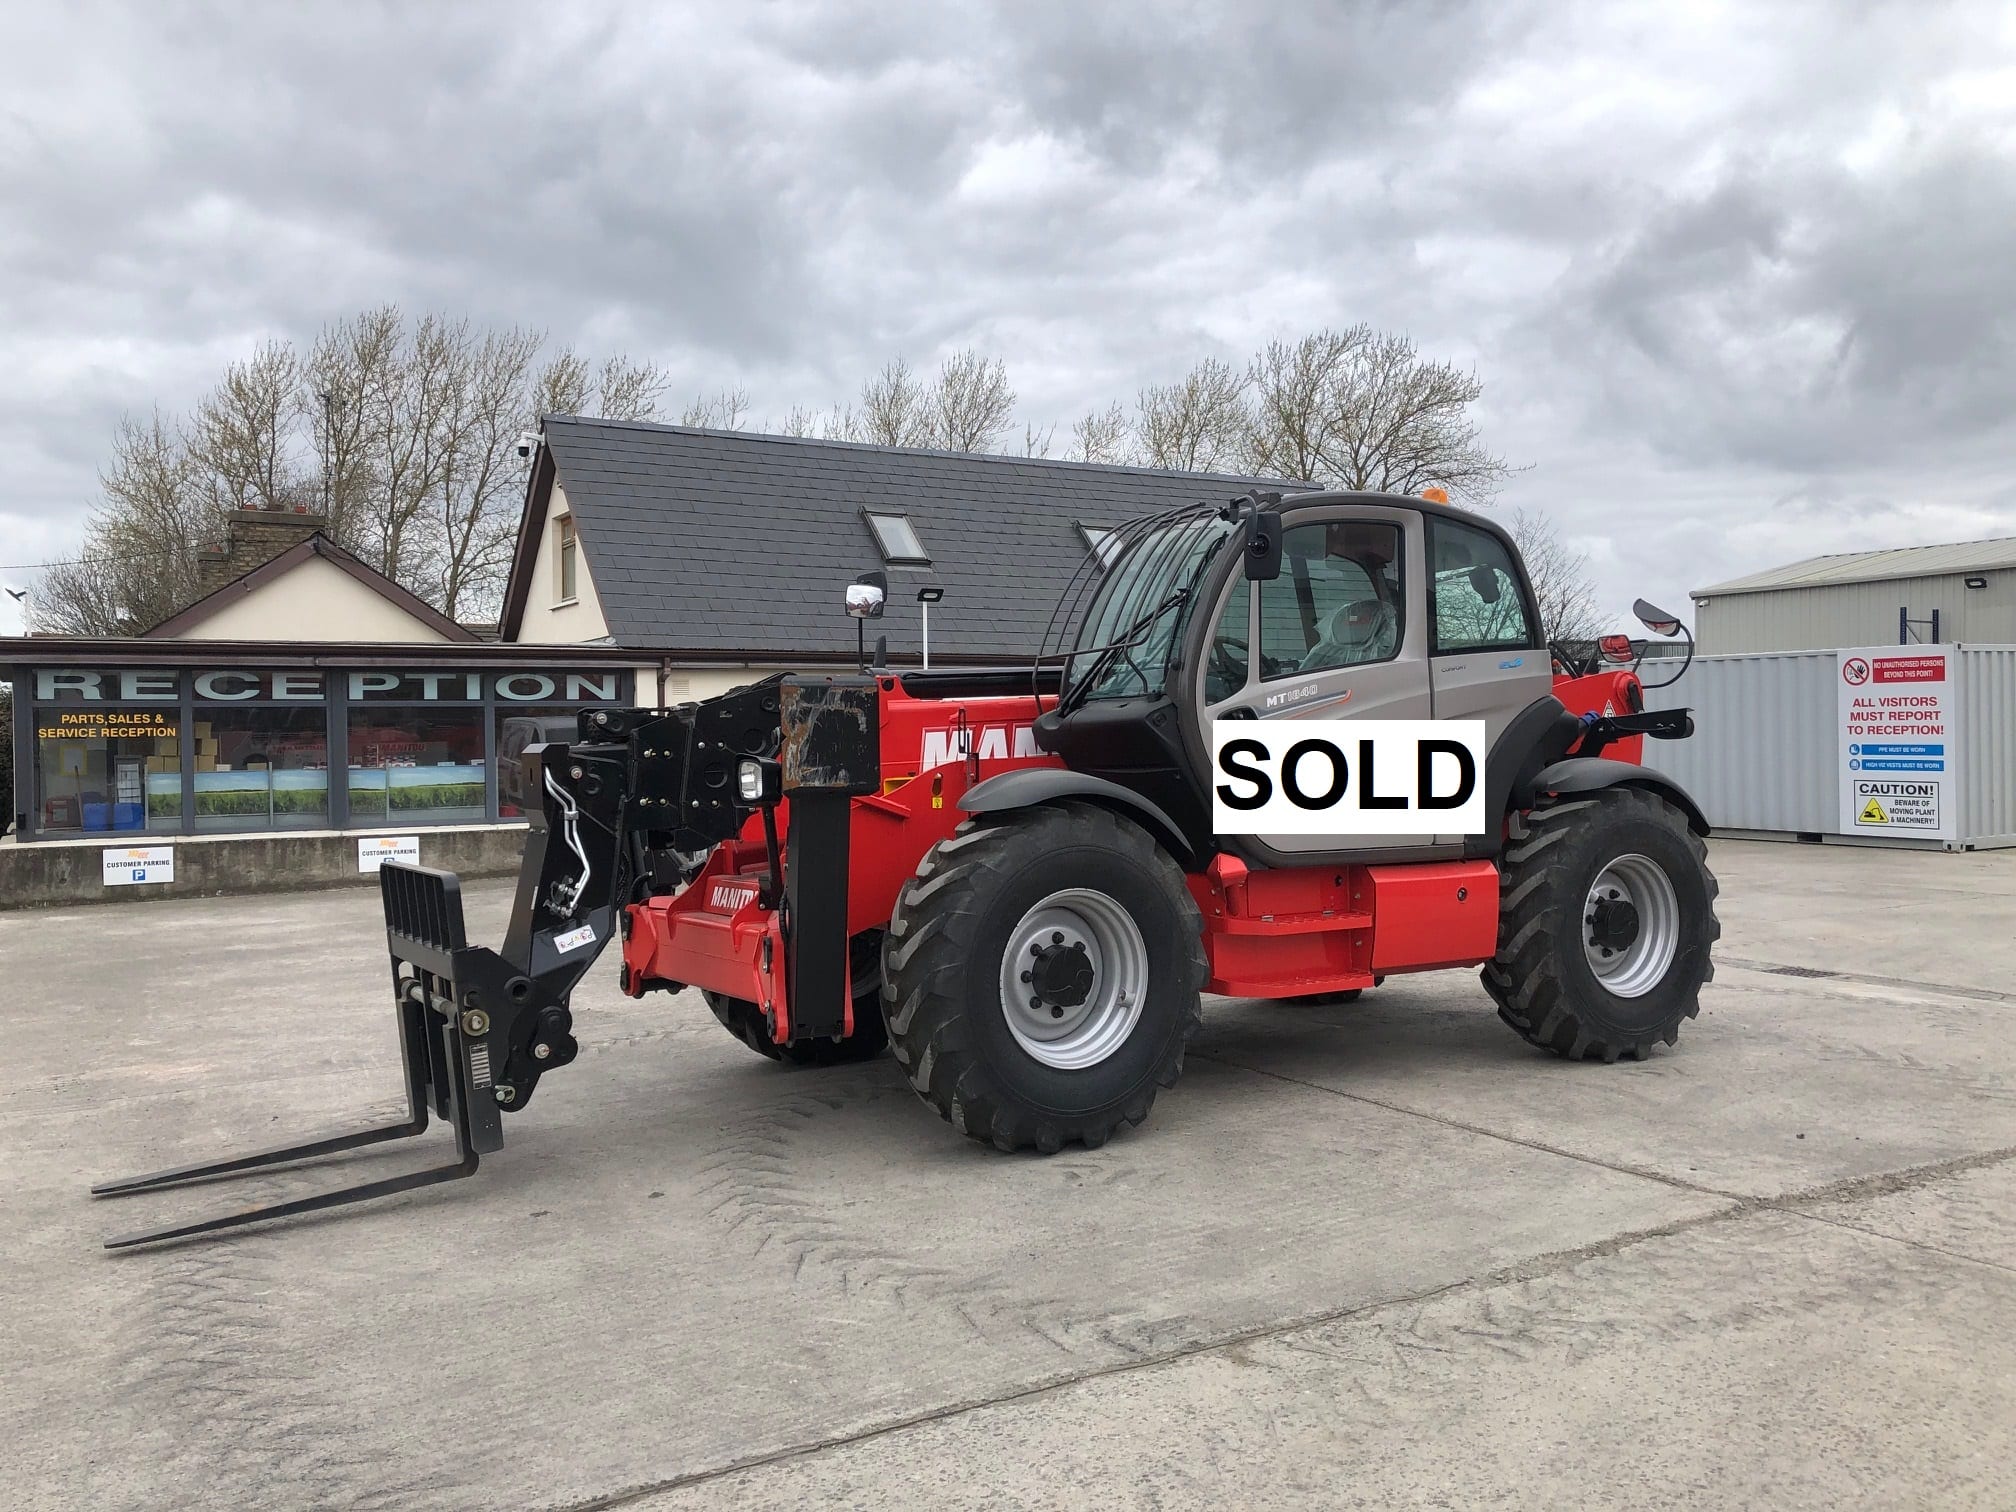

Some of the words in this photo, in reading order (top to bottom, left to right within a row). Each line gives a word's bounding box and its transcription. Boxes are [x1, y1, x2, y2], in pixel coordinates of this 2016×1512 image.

[1920, 659, 1944, 668] PERSONS
[37, 670, 616, 701] RECEPTION
[1853, 698, 1876, 707] ALL
[1879, 696, 1938, 706] VISITORS
[154, 714, 164, 724] &
[1850, 712, 1884, 721] MUST
[1888, 710, 1941, 720] REPORT
[38, 728, 97, 738] SERVICE
[101, 728, 176, 737] RECEPTION
[1847, 726, 1864, 735] TO
[1868, 726, 1944, 735] RECEPTION!
[1860, 784, 1934, 796] CAUTION!
